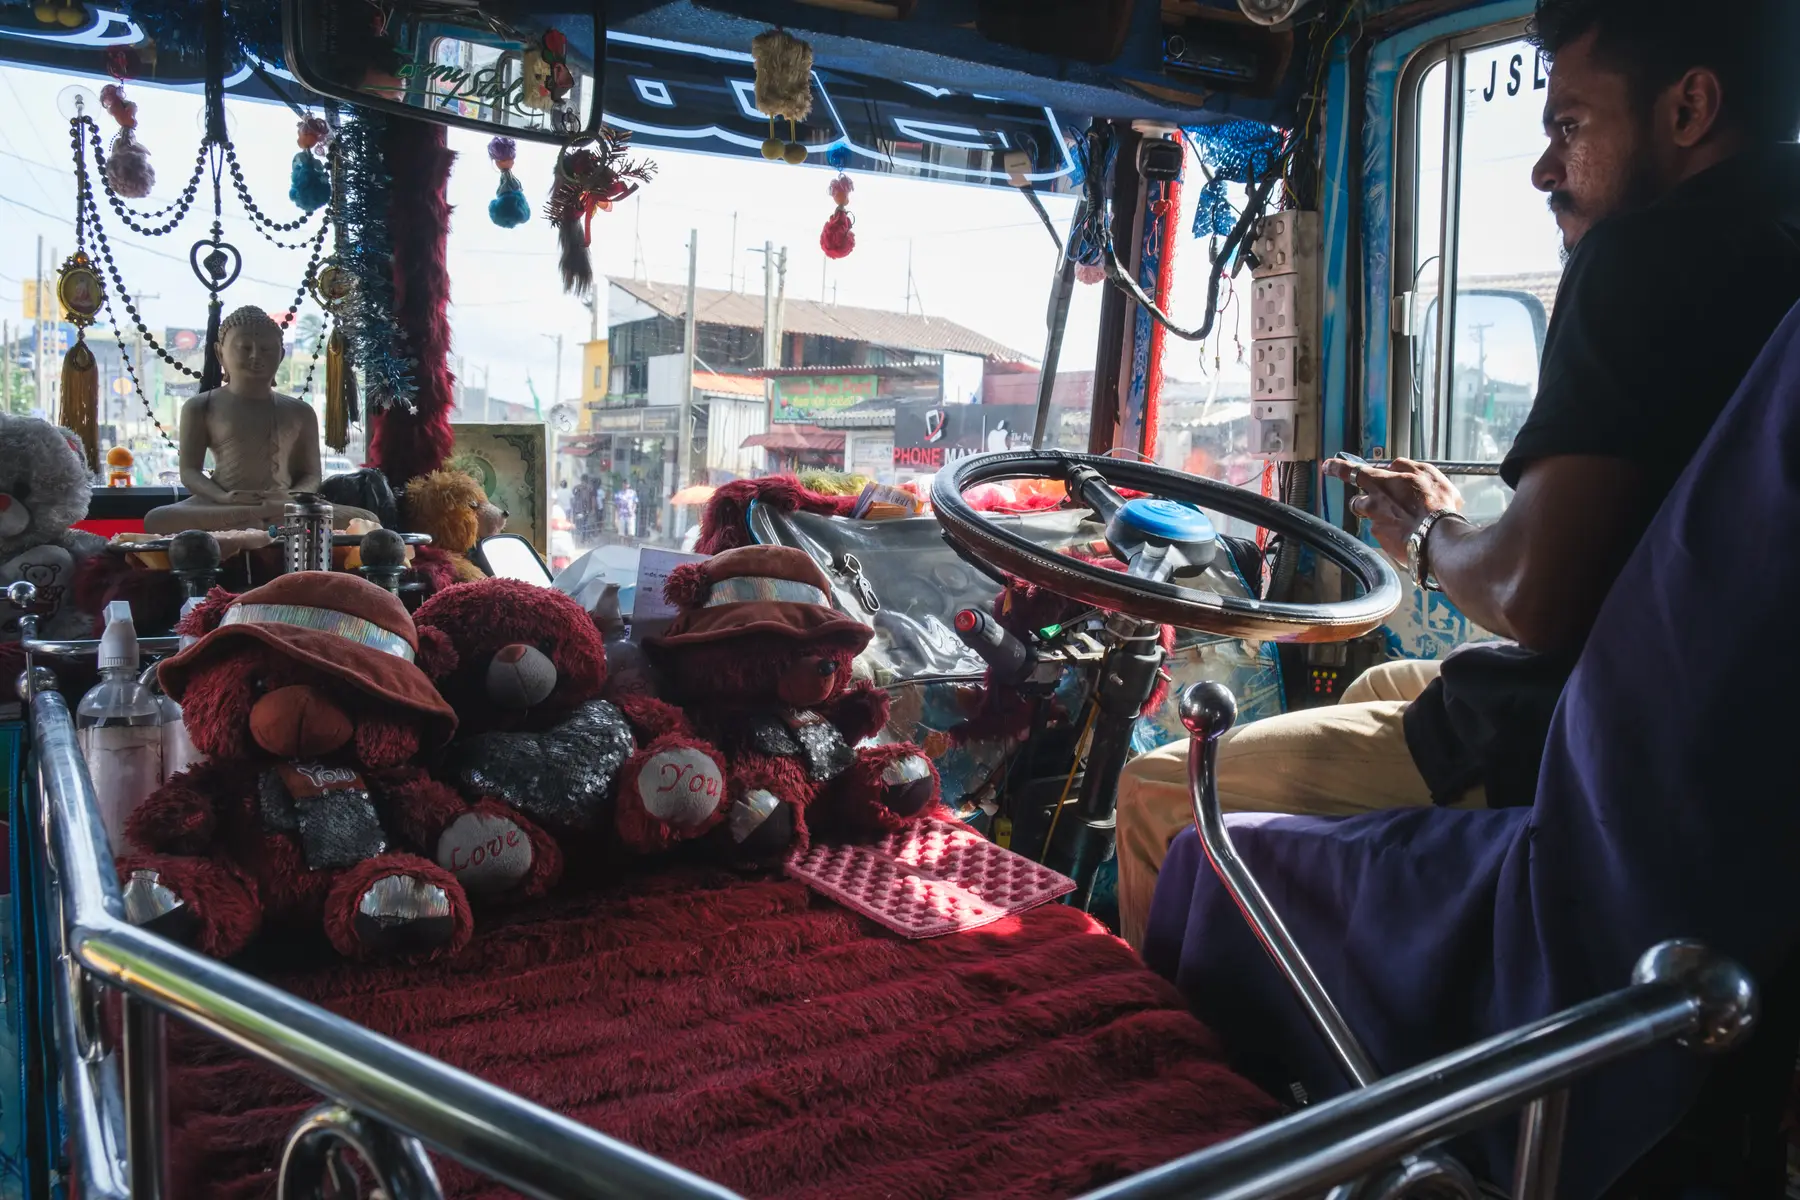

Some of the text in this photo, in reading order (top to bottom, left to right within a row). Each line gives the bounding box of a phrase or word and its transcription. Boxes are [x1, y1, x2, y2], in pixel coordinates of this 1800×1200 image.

[893, 447, 941, 467] PHONE
[656, 763, 719, 797] You
[449, 830, 519, 873] Love
